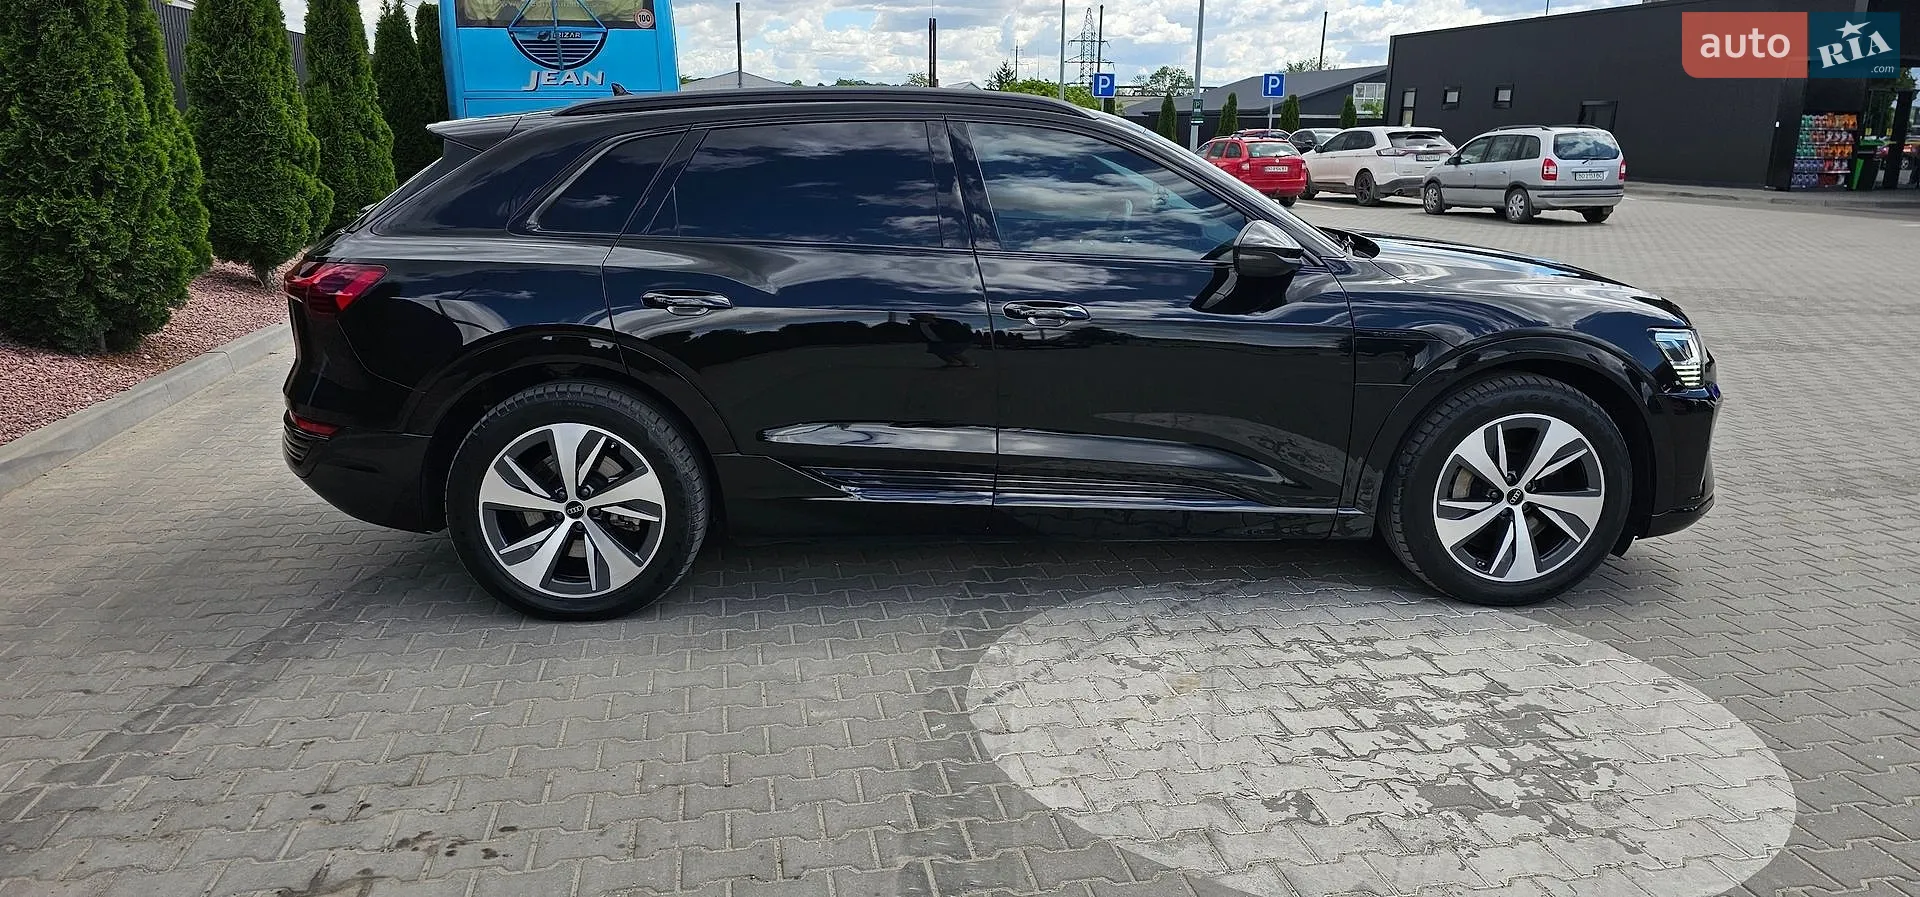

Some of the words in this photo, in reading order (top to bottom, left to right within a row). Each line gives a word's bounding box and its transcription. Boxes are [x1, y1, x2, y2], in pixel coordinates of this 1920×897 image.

[638, 14, 651, 23] 100
[522, 71, 604, 91] JEAN
[1099, 76, 1111, 94] P
[1268, 76, 1280, 94] P
